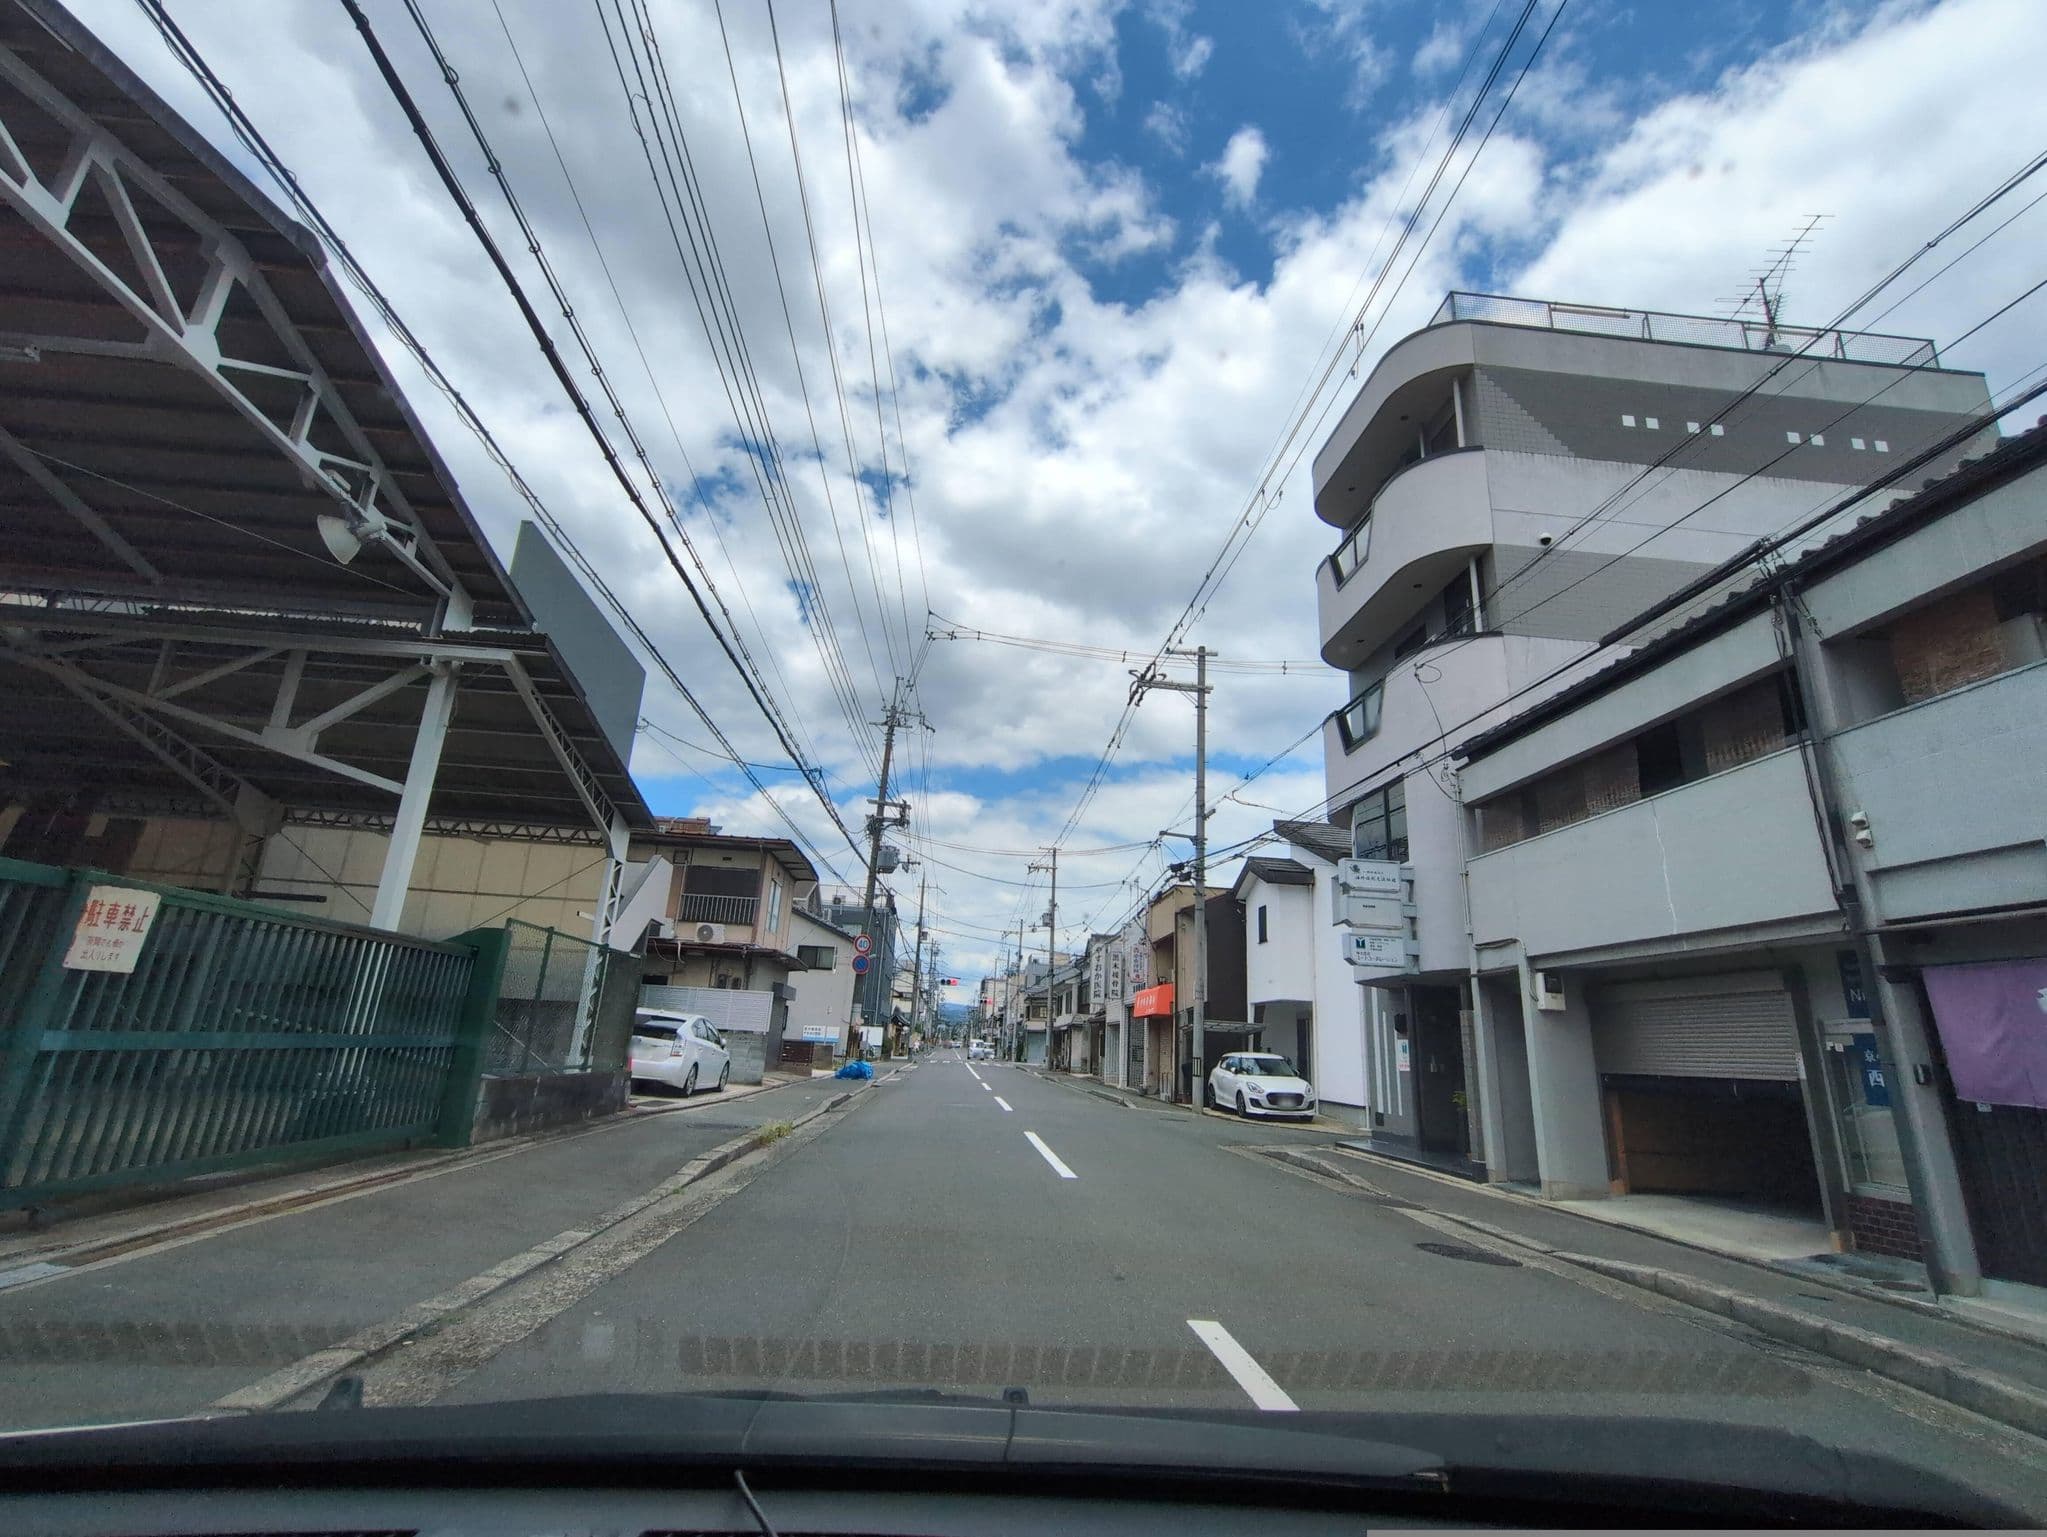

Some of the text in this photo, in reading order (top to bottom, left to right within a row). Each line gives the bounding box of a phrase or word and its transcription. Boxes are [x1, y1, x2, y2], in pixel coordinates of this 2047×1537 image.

[85, 899, 149, 933] 駐車禁止
[858, 939, 868, 949] 40
